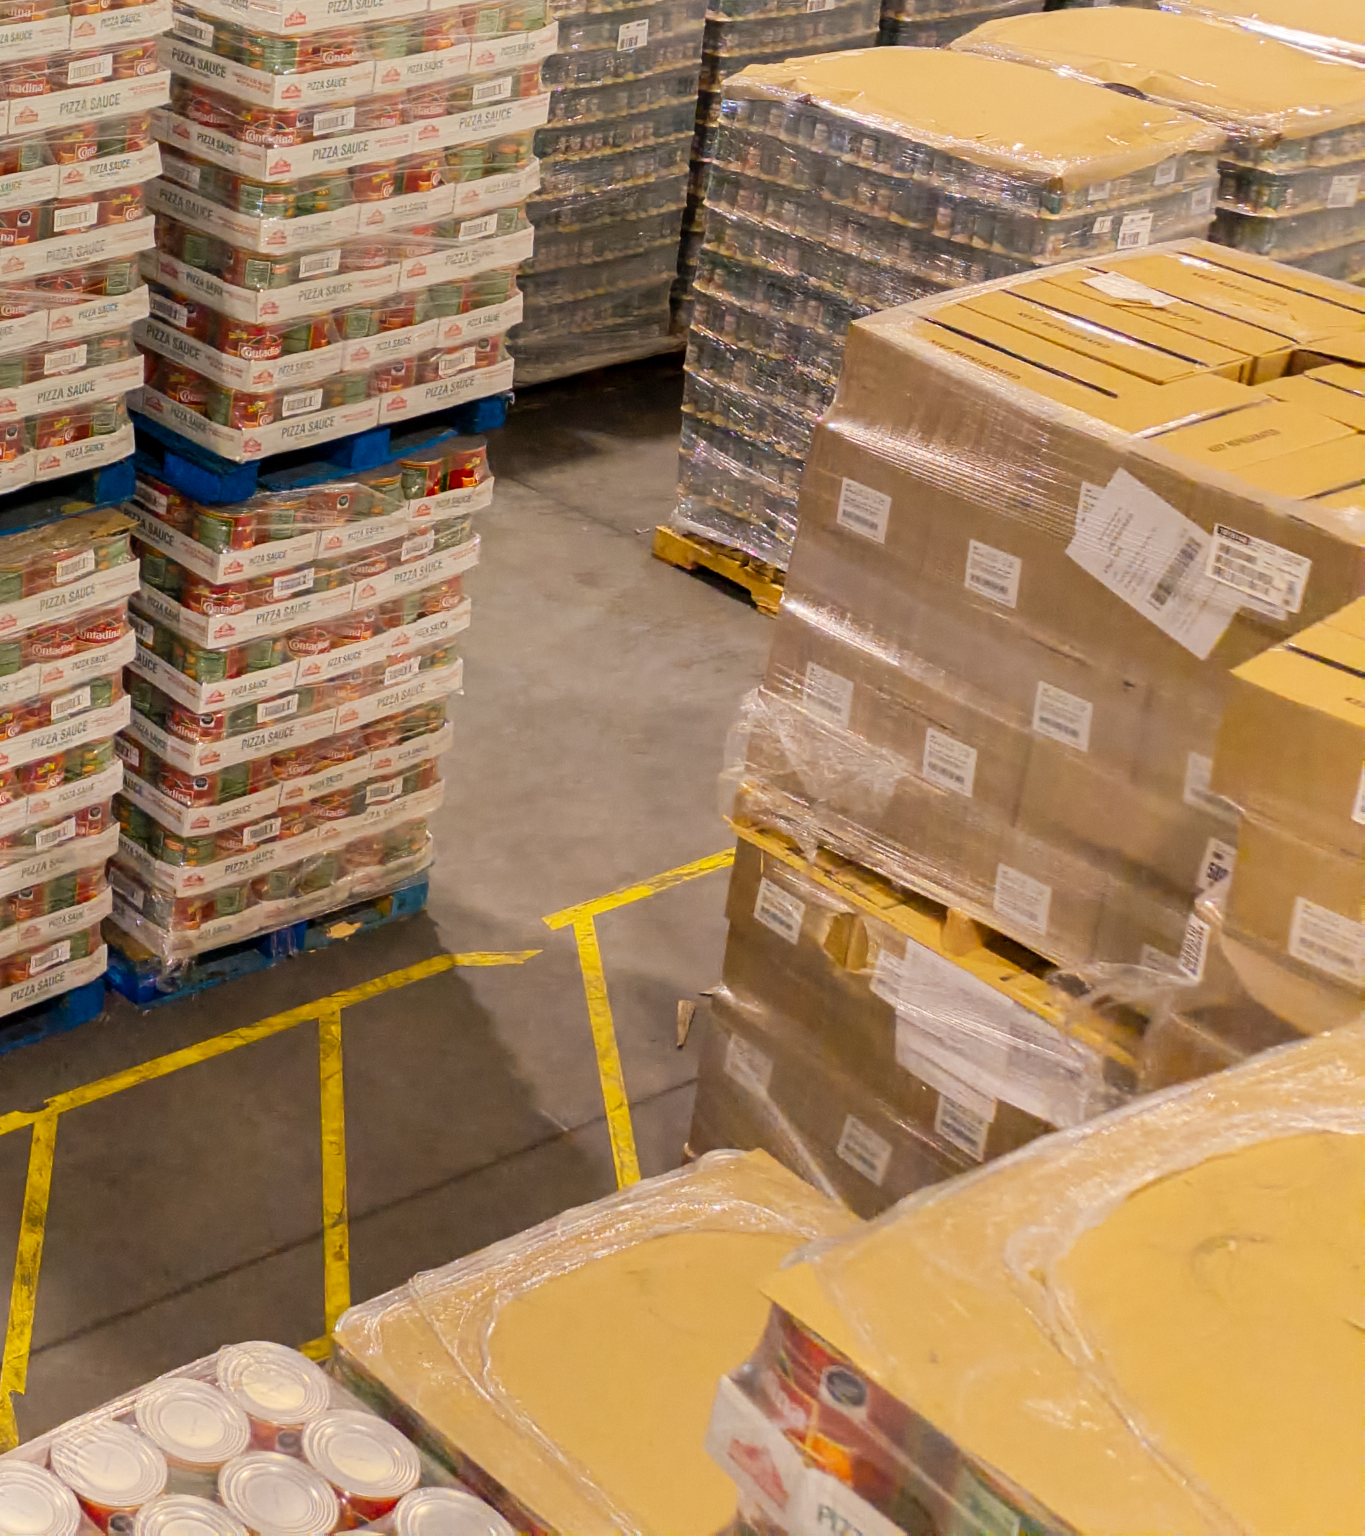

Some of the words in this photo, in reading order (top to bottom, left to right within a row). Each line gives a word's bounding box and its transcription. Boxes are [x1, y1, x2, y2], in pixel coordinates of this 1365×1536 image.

[327, 1, 355, 13] PIZZA
[11, 29, 33, 40] SAUCE
[307, 80, 325, 91] PIZZA
[327, 78, 347, 88] SAUCE
[60, 99, 87, 114] PIZZA
[90, 93, 120, 109] SAUCE
[313, 146, 339, 160] PIZZA
[343, 140, 368, 156] SAUCE
[298, 288, 322, 301] PIZZA
[325, 283, 352, 296] SAUCE
[146, 324, 169, 344] PIZZA
[173, 340, 201, 360] SAUCE
[37, 388, 65, 404] PIZZA
[67, 381, 96, 397] SAUCE
[425, 385, 448, 398] PIZZA
[451, 377, 474, 393] SAUCE
[281, 425, 305, 438] PIZZA
[308, 416, 335, 433] SAUCE
[241, 735, 266, 749] PIZZA
[269, 726, 294, 742] SAUCE
[11, 987, 35, 1002] PIZZA
[38, 972, 65, 992] SAUCE
